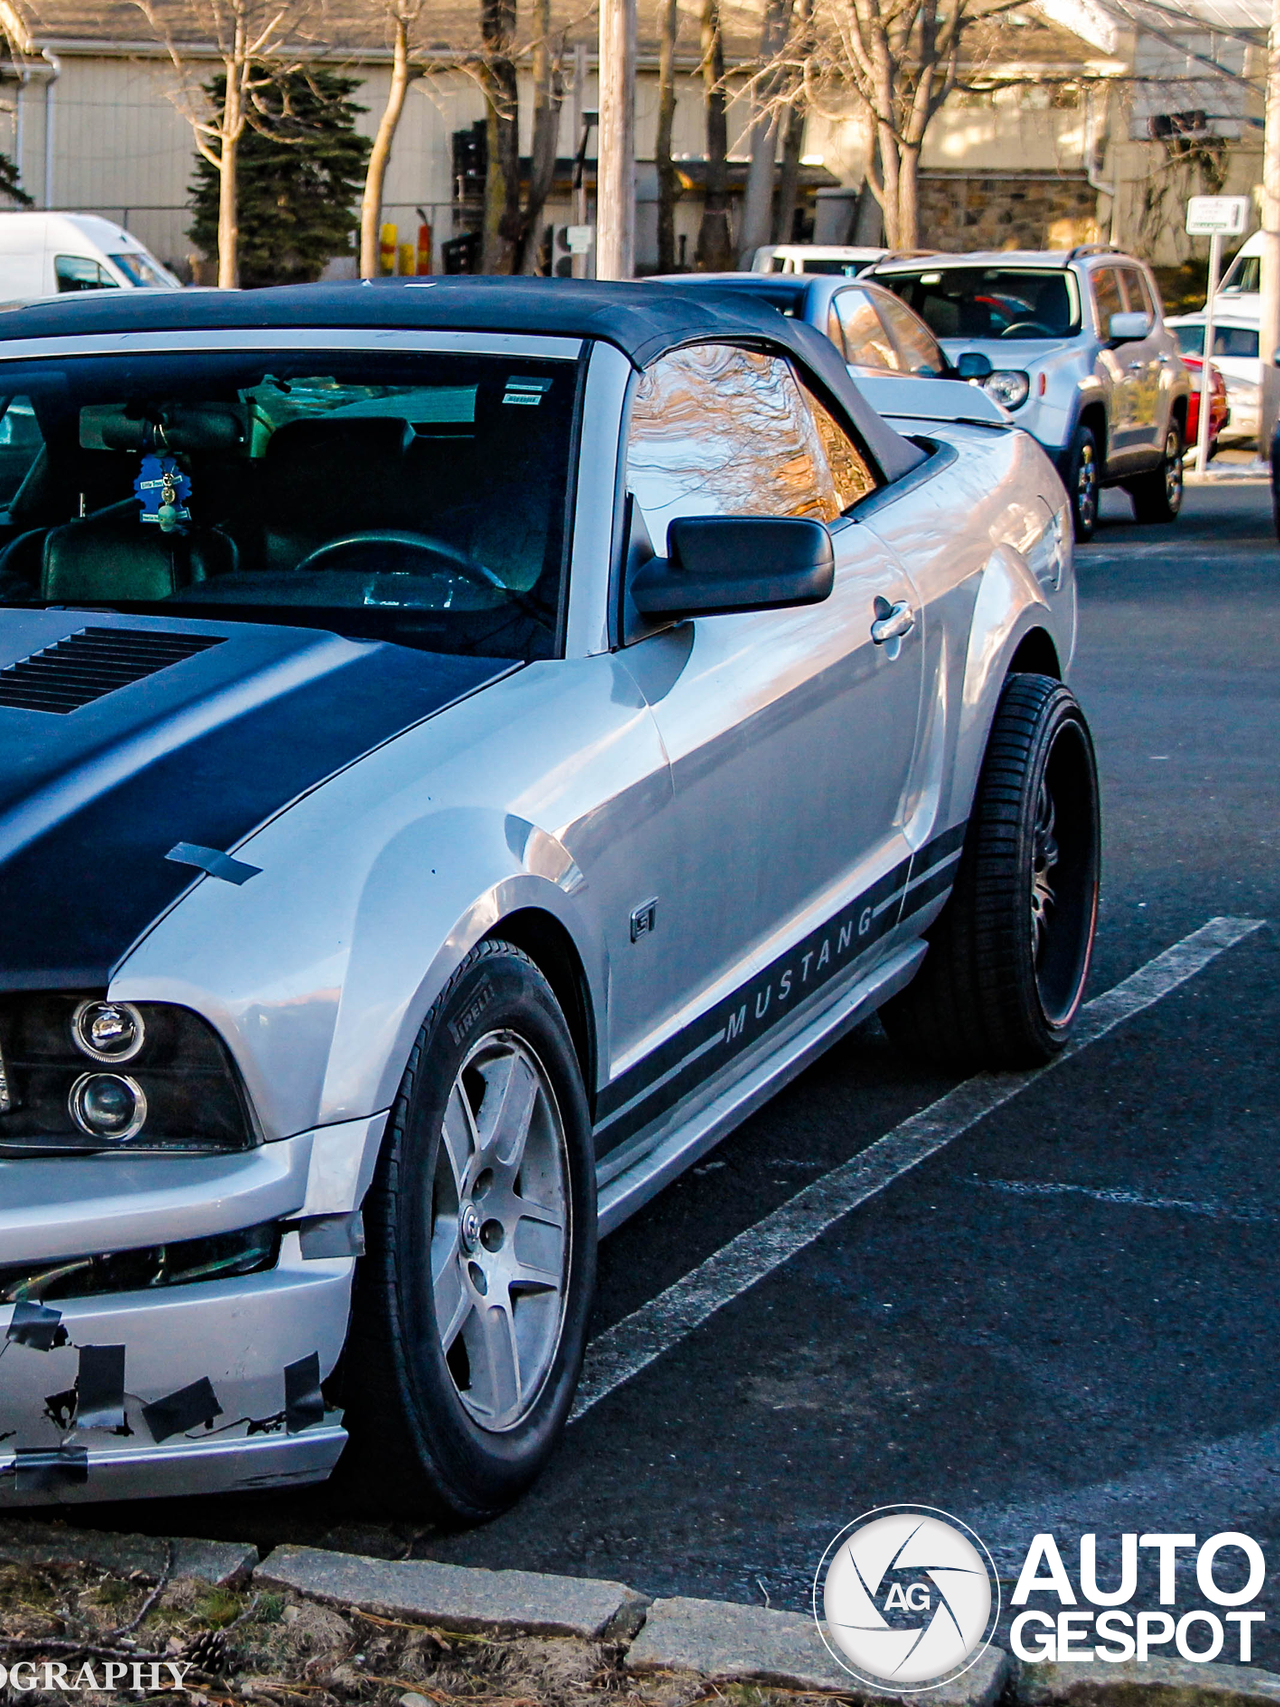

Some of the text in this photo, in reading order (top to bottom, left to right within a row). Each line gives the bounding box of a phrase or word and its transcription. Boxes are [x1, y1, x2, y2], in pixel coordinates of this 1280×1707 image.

[628, 895, 660, 945] GT
[446, 973, 495, 1046] PIRELLI
[725, 906, 873, 1044] MUSTANG
